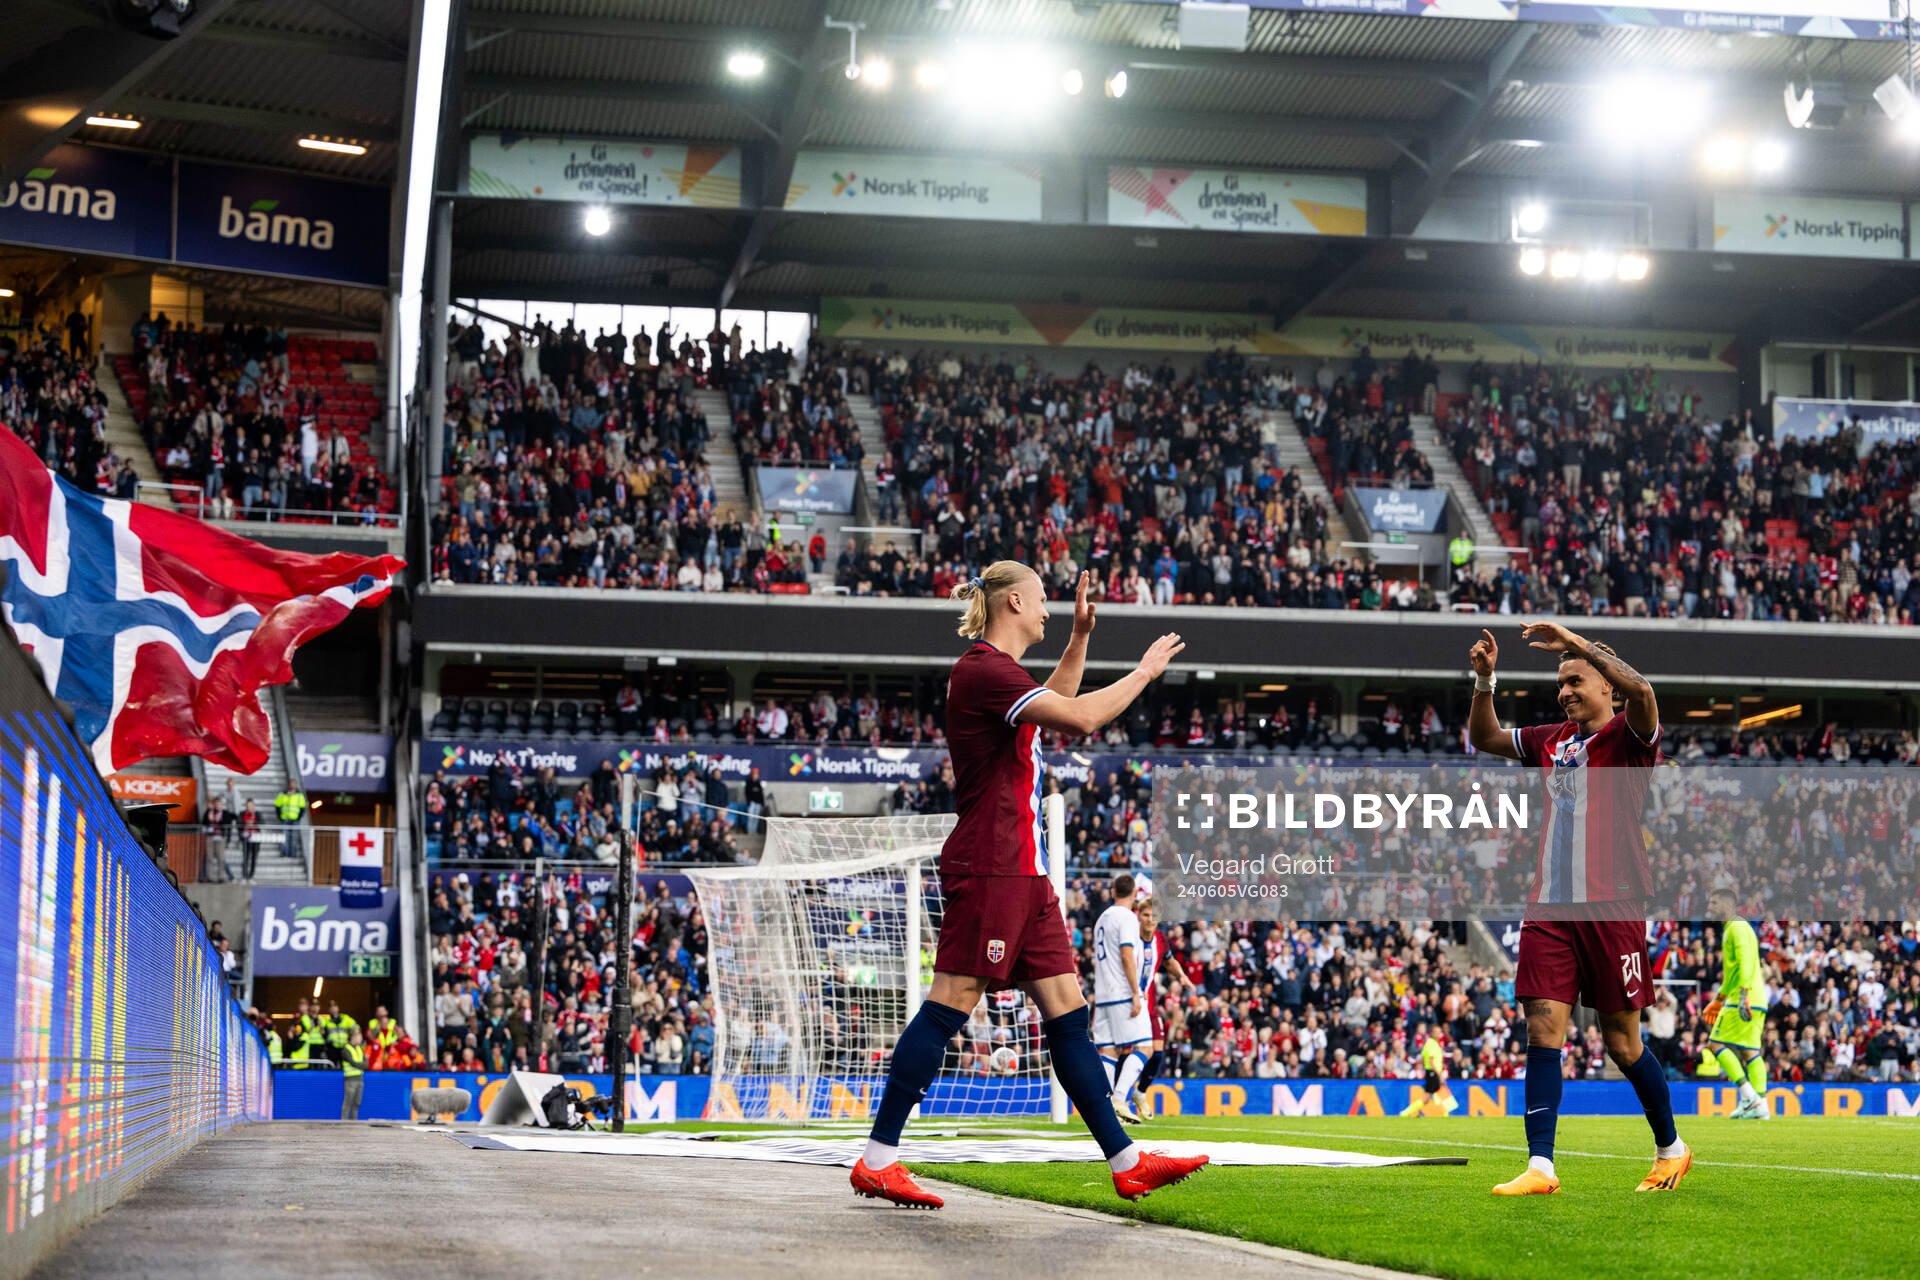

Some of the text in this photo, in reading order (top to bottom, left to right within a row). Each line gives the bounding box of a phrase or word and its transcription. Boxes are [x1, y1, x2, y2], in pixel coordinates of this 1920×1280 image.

[863, 177, 990, 204] Norsk Tipping
[219, 196, 334, 251] bama
[1794, 219, 1844, 238] Norsk
[898, 313, 1010, 335] Norsk Tipping
[296, 744, 386, 779] bama
[469, 749, 577, 772] Nok Tpping
[645, 753, 752, 776] Nrs Tpping
[816, 758, 921, 778] Norsk Tipping
[1041, 762, 1089, 783] ping
[1155, 764, 1257, 783] Nok Tiping
[1365, 768, 1420, 790] Tiing
[1483, 771, 1518, 788] Nors
[124, 779, 182, 796] KIOSK
[1703, 776, 1741, 796] ping
[1801, 778, 1842, 794] Nosk
[260, 905, 389, 951] bama
[1620, 951, 1642, 987] 20
[1070, 1081, 1508, 1117] ÖRMANN
